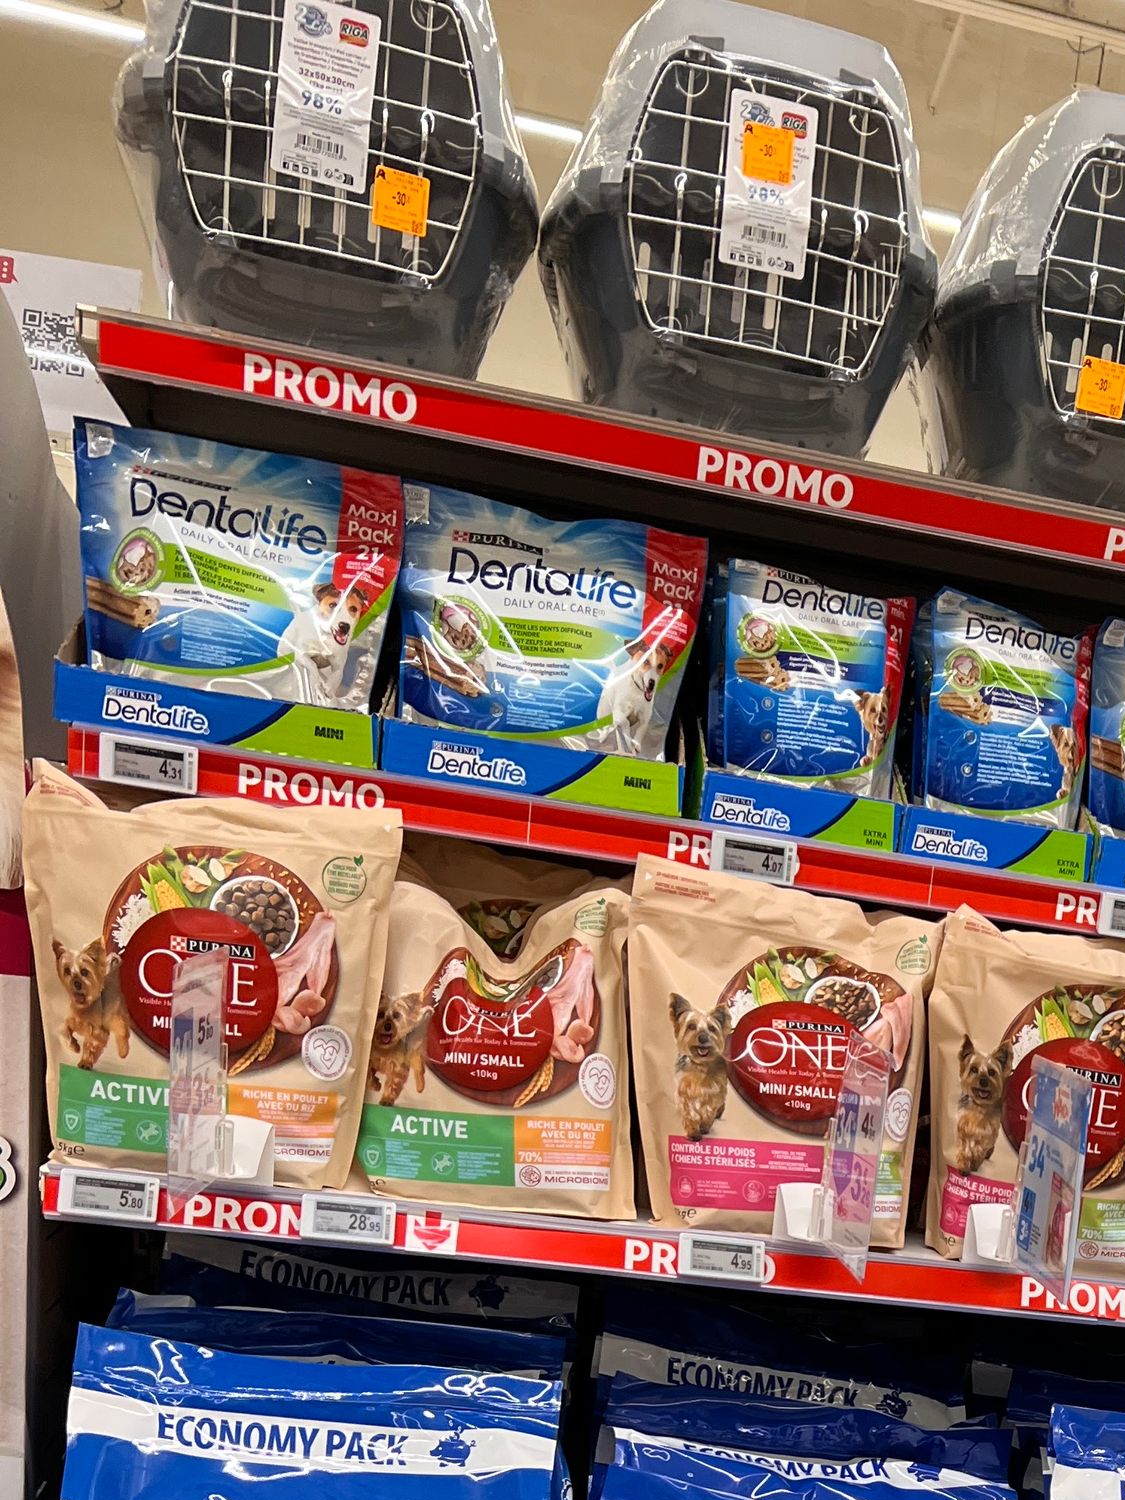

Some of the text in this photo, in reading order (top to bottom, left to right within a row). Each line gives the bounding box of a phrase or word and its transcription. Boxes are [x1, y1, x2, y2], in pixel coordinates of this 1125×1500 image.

[340, 23, 369, 41] RIGA
[301, 90, 343, 115] 98%
[781, 117, 807, 132] RIGA
[242, 351, 418, 423] PROMO
[697, 446, 854, 508] PROMO
[130, 477, 328, 556] Dentalife
[348, 502, 397, 528] Maxi
[180, 526, 285, 564] DAILY CARE
[348, 522, 395, 546] Pack
[447, 547, 637, 609] Dentalife
[652, 560, 698, 583] Maxi
[654, 580, 695, 601] Pack
[762, 580, 884, 620] Dentalife
[503, 597, 599, 617] DAILY ORAL CARE
[105, 698, 208, 734] Dentalife
[314, 725, 344, 740] MINI
[442, 743, 476, 755] PURINA
[430, 752, 526, 785] Dentalife
[238, 763, 385, 809] PROMO
[624, 776, 651, 790] MINI
[712, 802, 791, 832] Dentalife
[863, 829, 887, 840] EXTRA
[866, 837, 883, 847] MINI
[913, 834, 989, 862] Dentalife
[1057, 859, 1080, 870] EXTRA
[1059, 868, 1076, 877] MINI
[189, 940, 253, 958] PURNA
[443, 995, 537, 1038] ONE
[788, 1021, 843, 1034] PURINA
[747, 1027, 849, 1070] ONE
[242, 1089, 329, 1104] RICHE EN POULET
[256, 1100, 283, 1110] AVEC
[391, 1114, 468, 1139] ACTIVE
[527, 1120, 605, 1132] RICHE EN POULET
[541, 1130, 596, 1140] AVEC DU RIZ
[518, 1152, 542, 1163] 70%
[671, 1140, 755, 1157] CONTRÔLE DU POIDS
[676, 1155, 702, 1165] CHIENS
[382, 1275, 453, 1306] PACK
[156, 1413, 409, 1467] ECONOMY PACK
